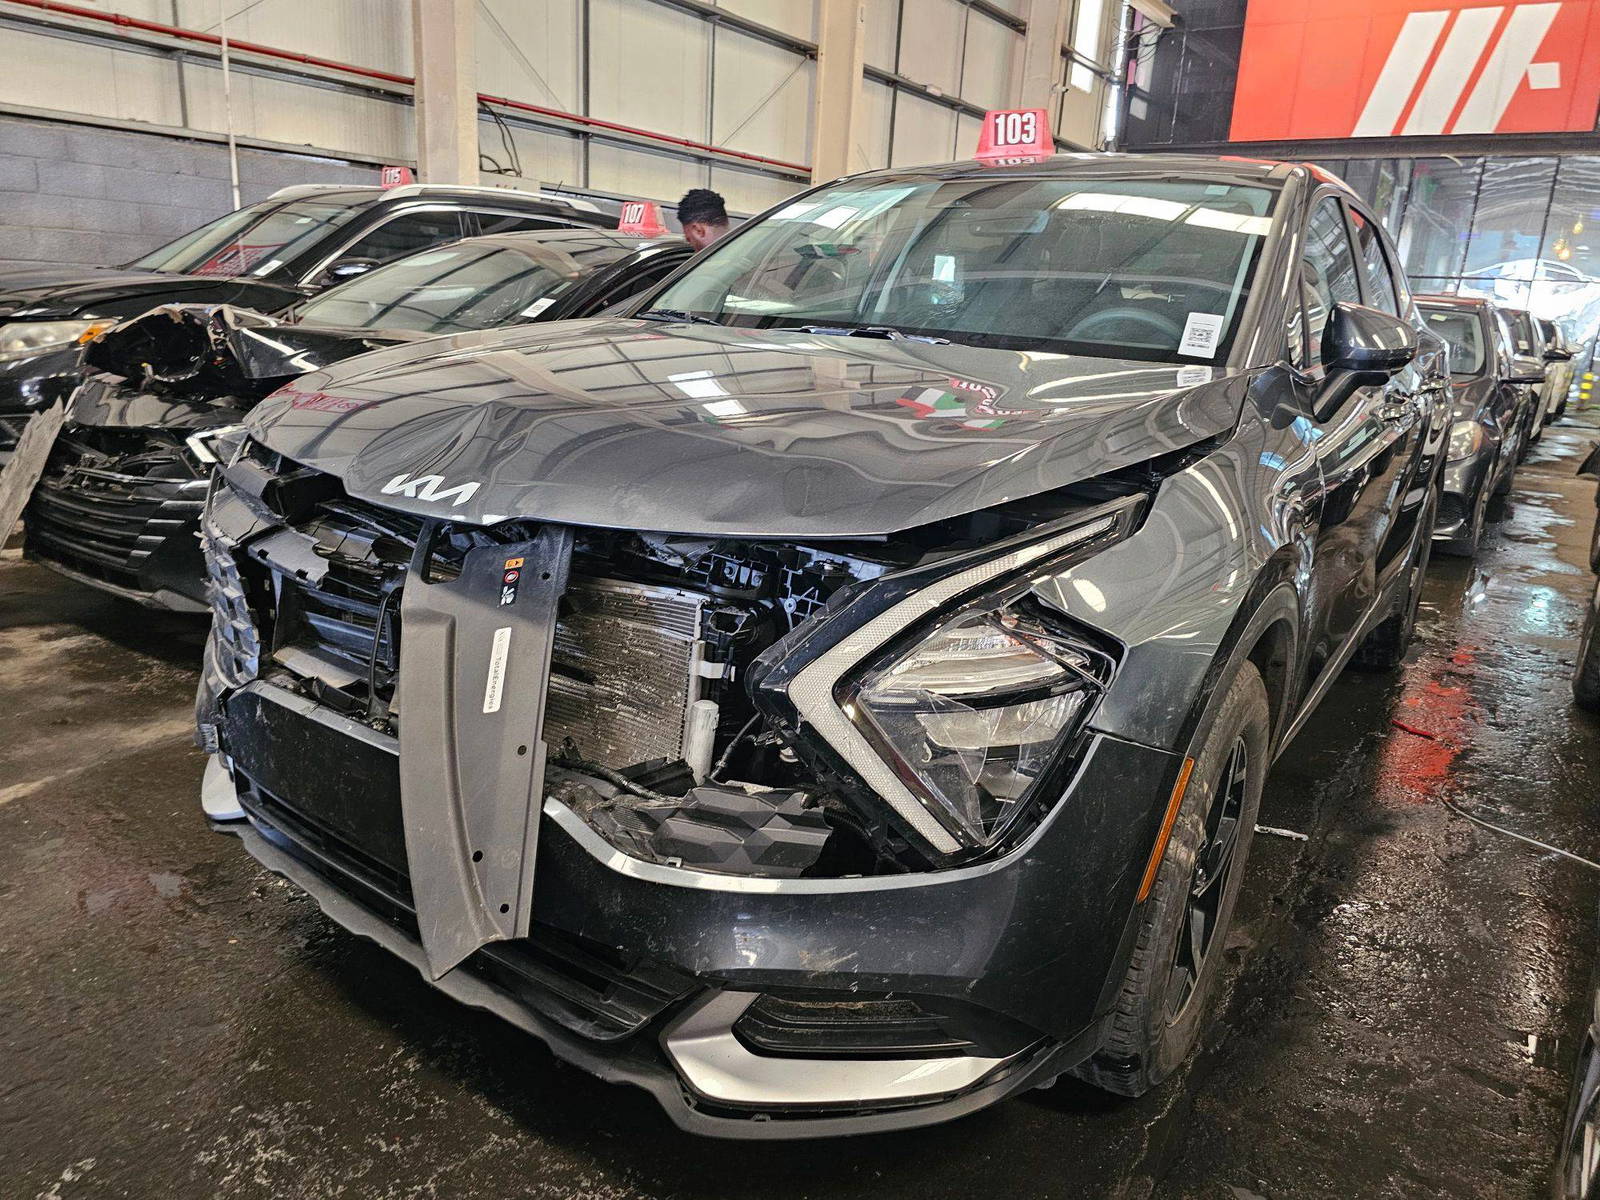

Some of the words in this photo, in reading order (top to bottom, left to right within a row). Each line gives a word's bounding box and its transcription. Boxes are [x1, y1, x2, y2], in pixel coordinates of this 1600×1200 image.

[995, 112, 1036, 145] 103
[385, 169, 401, 184] 115
[623, 203, 645, 223] 107
[381, 473, 481, 506] KIA
[488, 656, 502, 709] TotalEnergies
